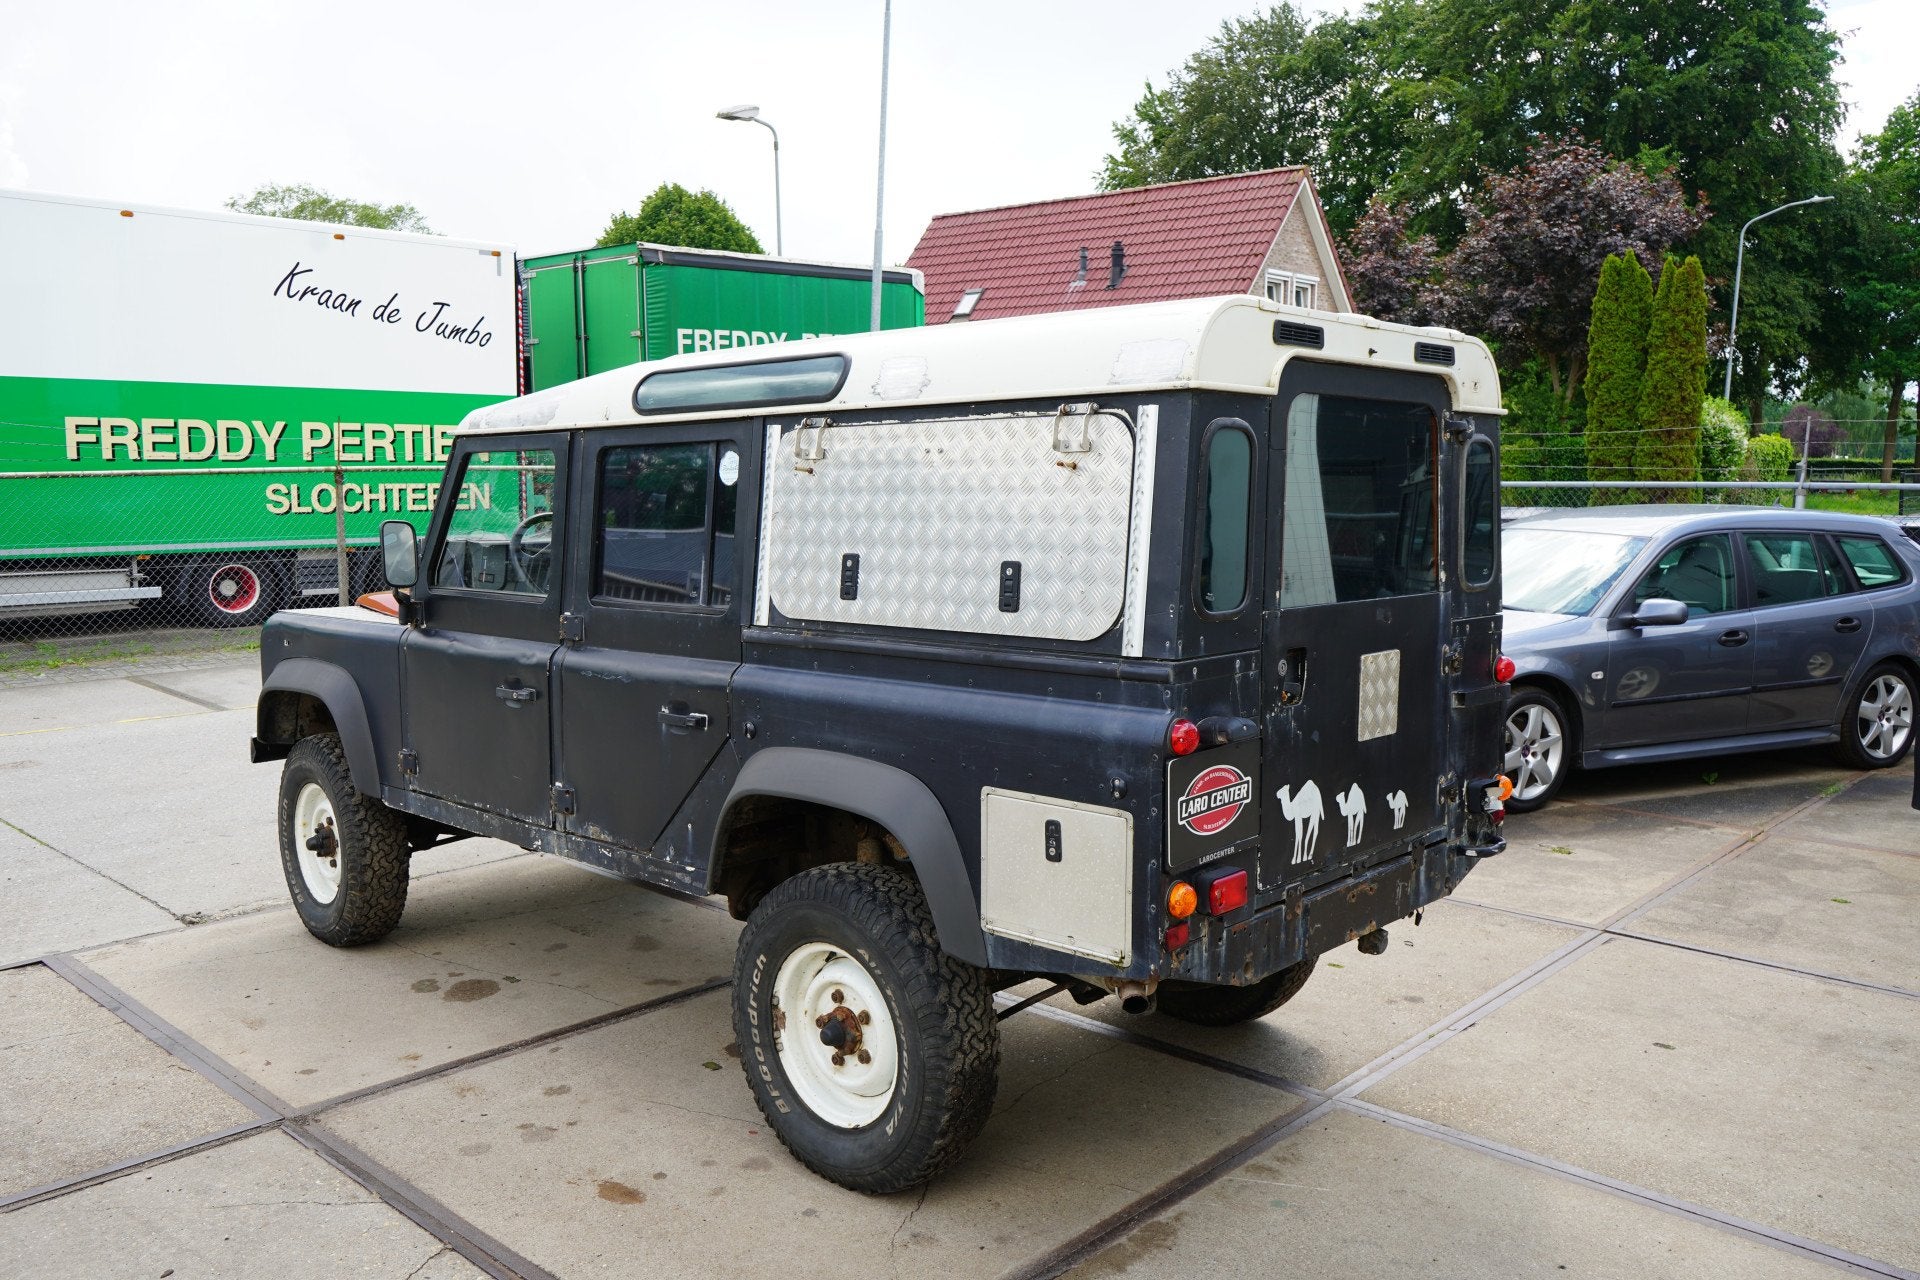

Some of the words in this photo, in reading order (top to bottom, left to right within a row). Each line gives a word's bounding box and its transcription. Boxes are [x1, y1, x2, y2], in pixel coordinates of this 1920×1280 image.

[273, 261, 362, 317] Kraan
[372, 292, 402, 324] de
[415, 301, 492, 348] Jumbo
[64, 416, 288, 462] FREDDY
[301, 421, 490, 463] PERTIE
[1181, 795, 1209, 818] LARO
[1210, 783, 1249, 808] CENTER
[1198, 846, 1235, 865] LAROCENTER
[746, 954, 792, 1115] BFGoodrich
